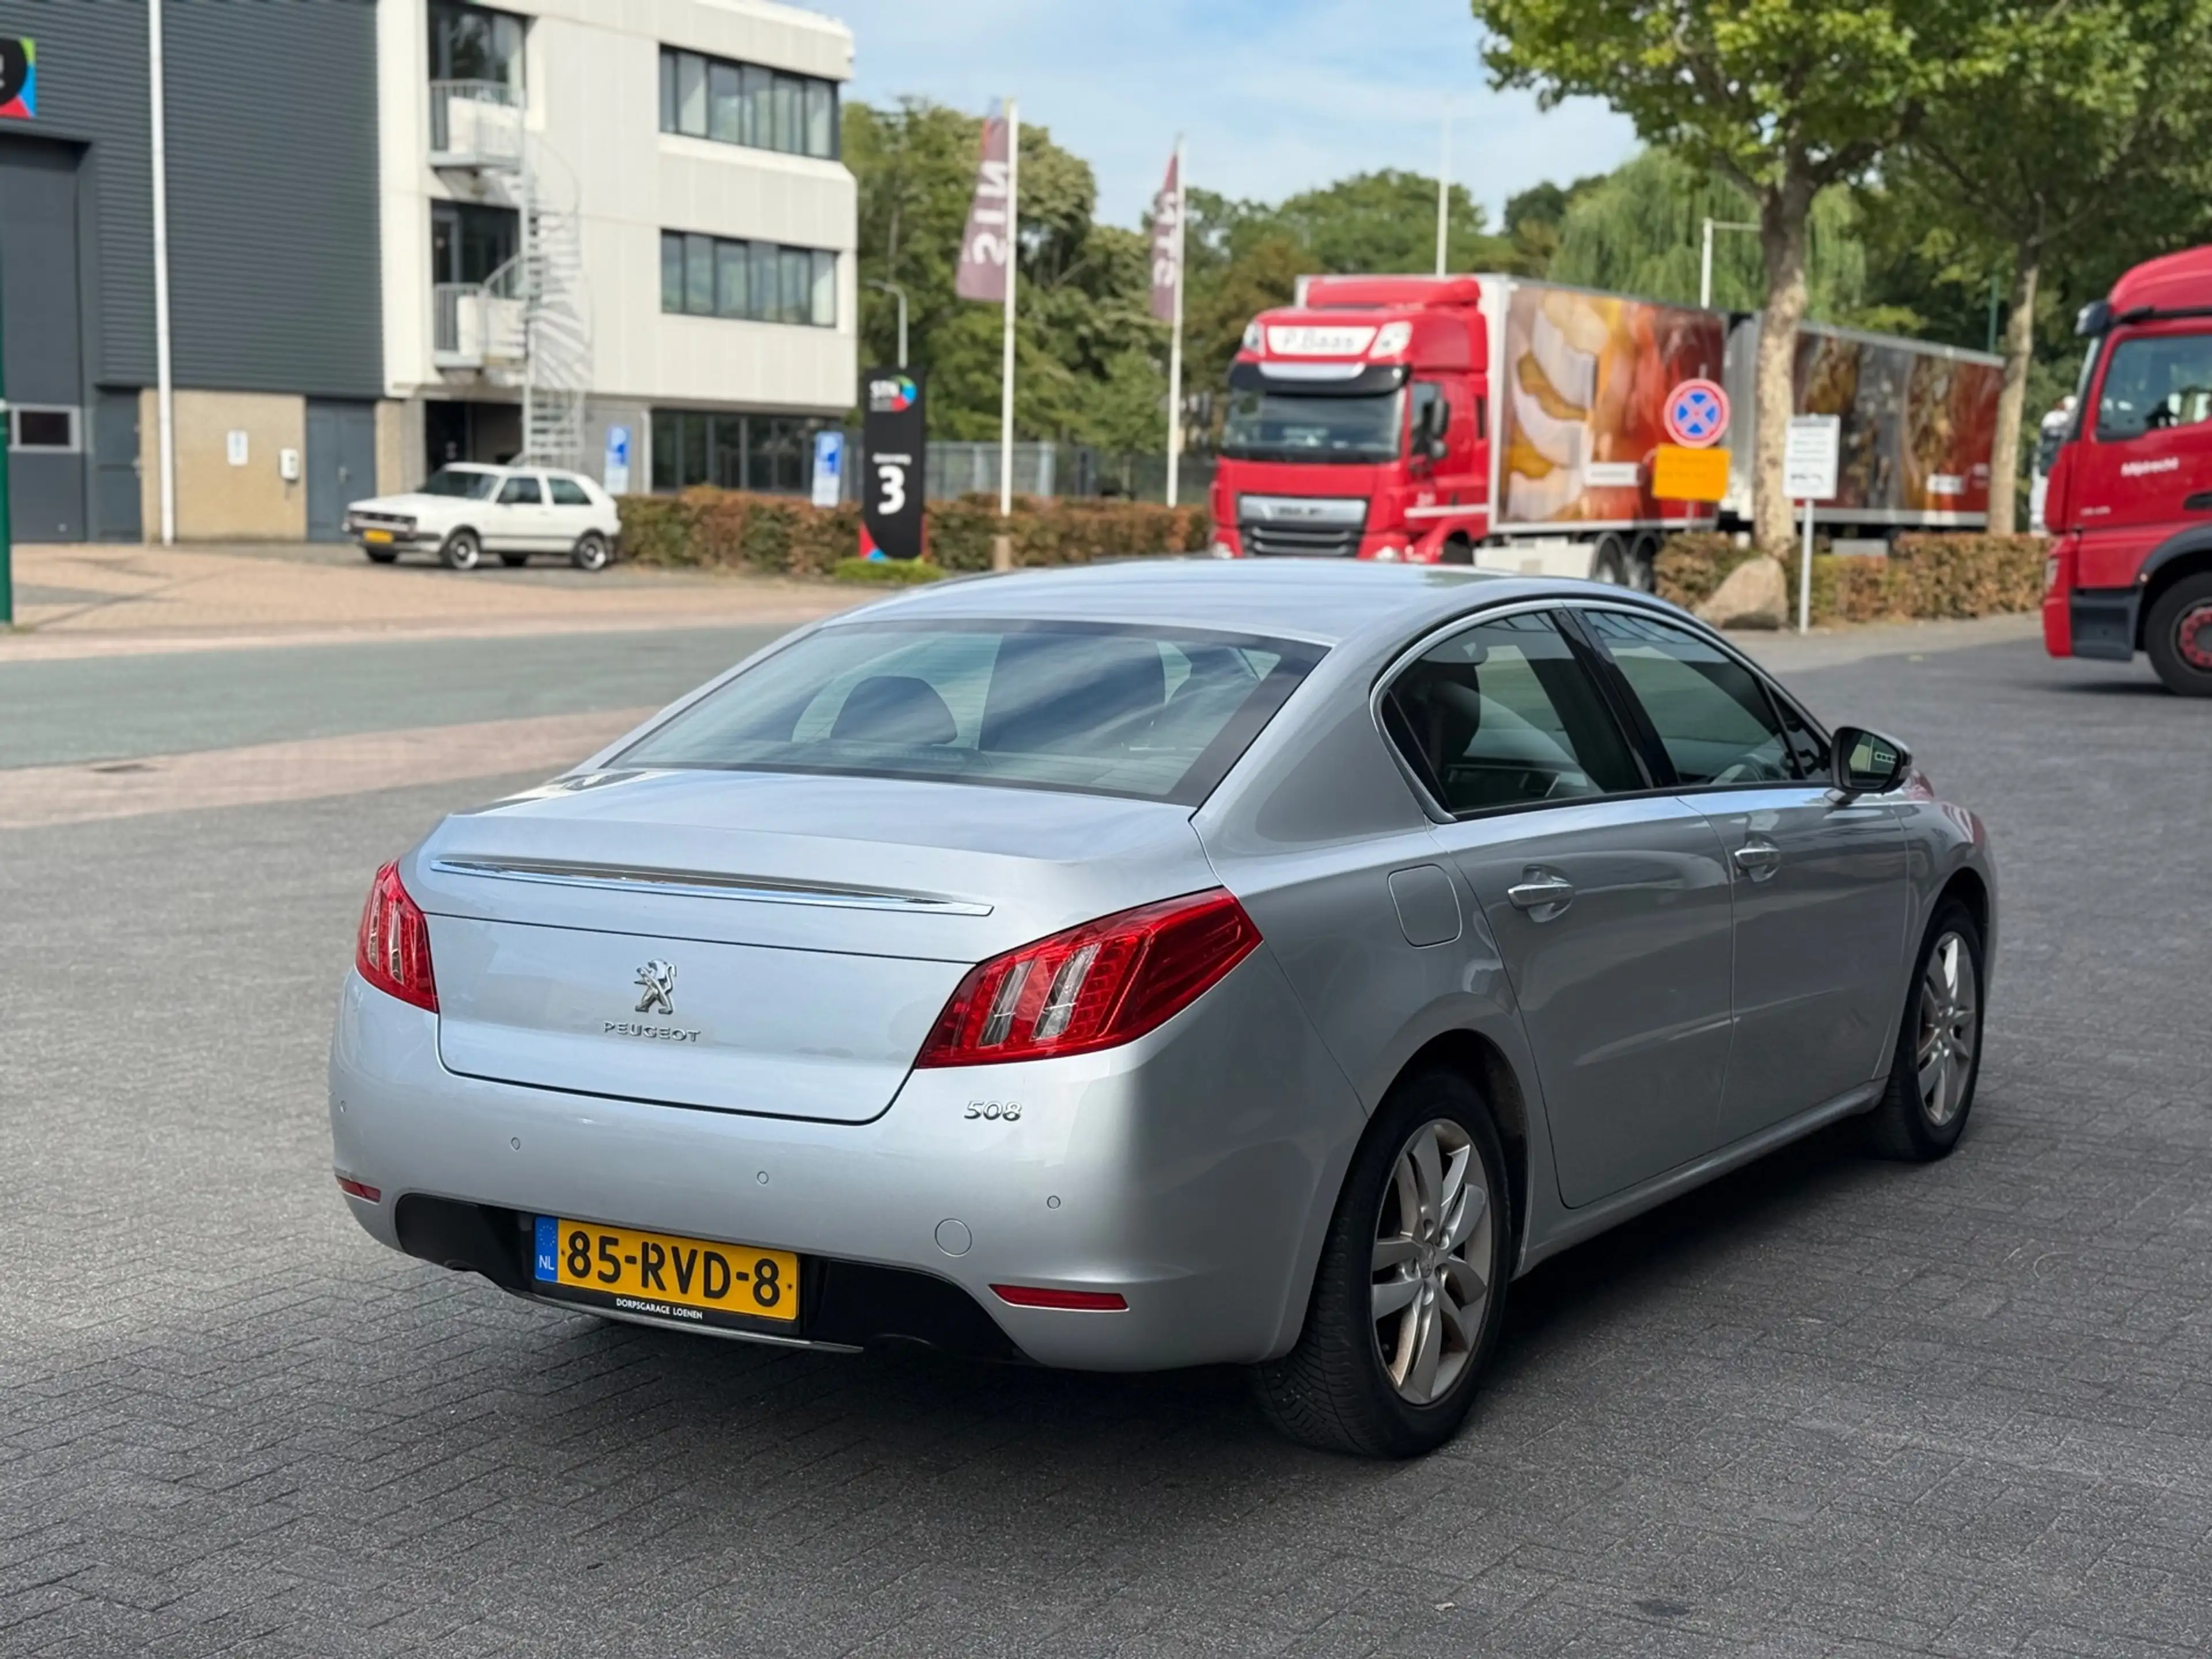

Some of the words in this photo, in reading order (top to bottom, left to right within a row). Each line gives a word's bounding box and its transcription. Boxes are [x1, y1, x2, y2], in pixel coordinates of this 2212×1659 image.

[877, 466, 905, 515] 3
[603, 1021, 701, 1043] PEUGEOT
[964, 1100, 1022, 1122] 508
[539, 1255, 555, 1271] NL
[567, 1230, 781, 1308] 85-RVD-8
[616, 1298, 671, 1315] DORPSGARAGE
[673, 1306, 703, 1320] LOENEN
